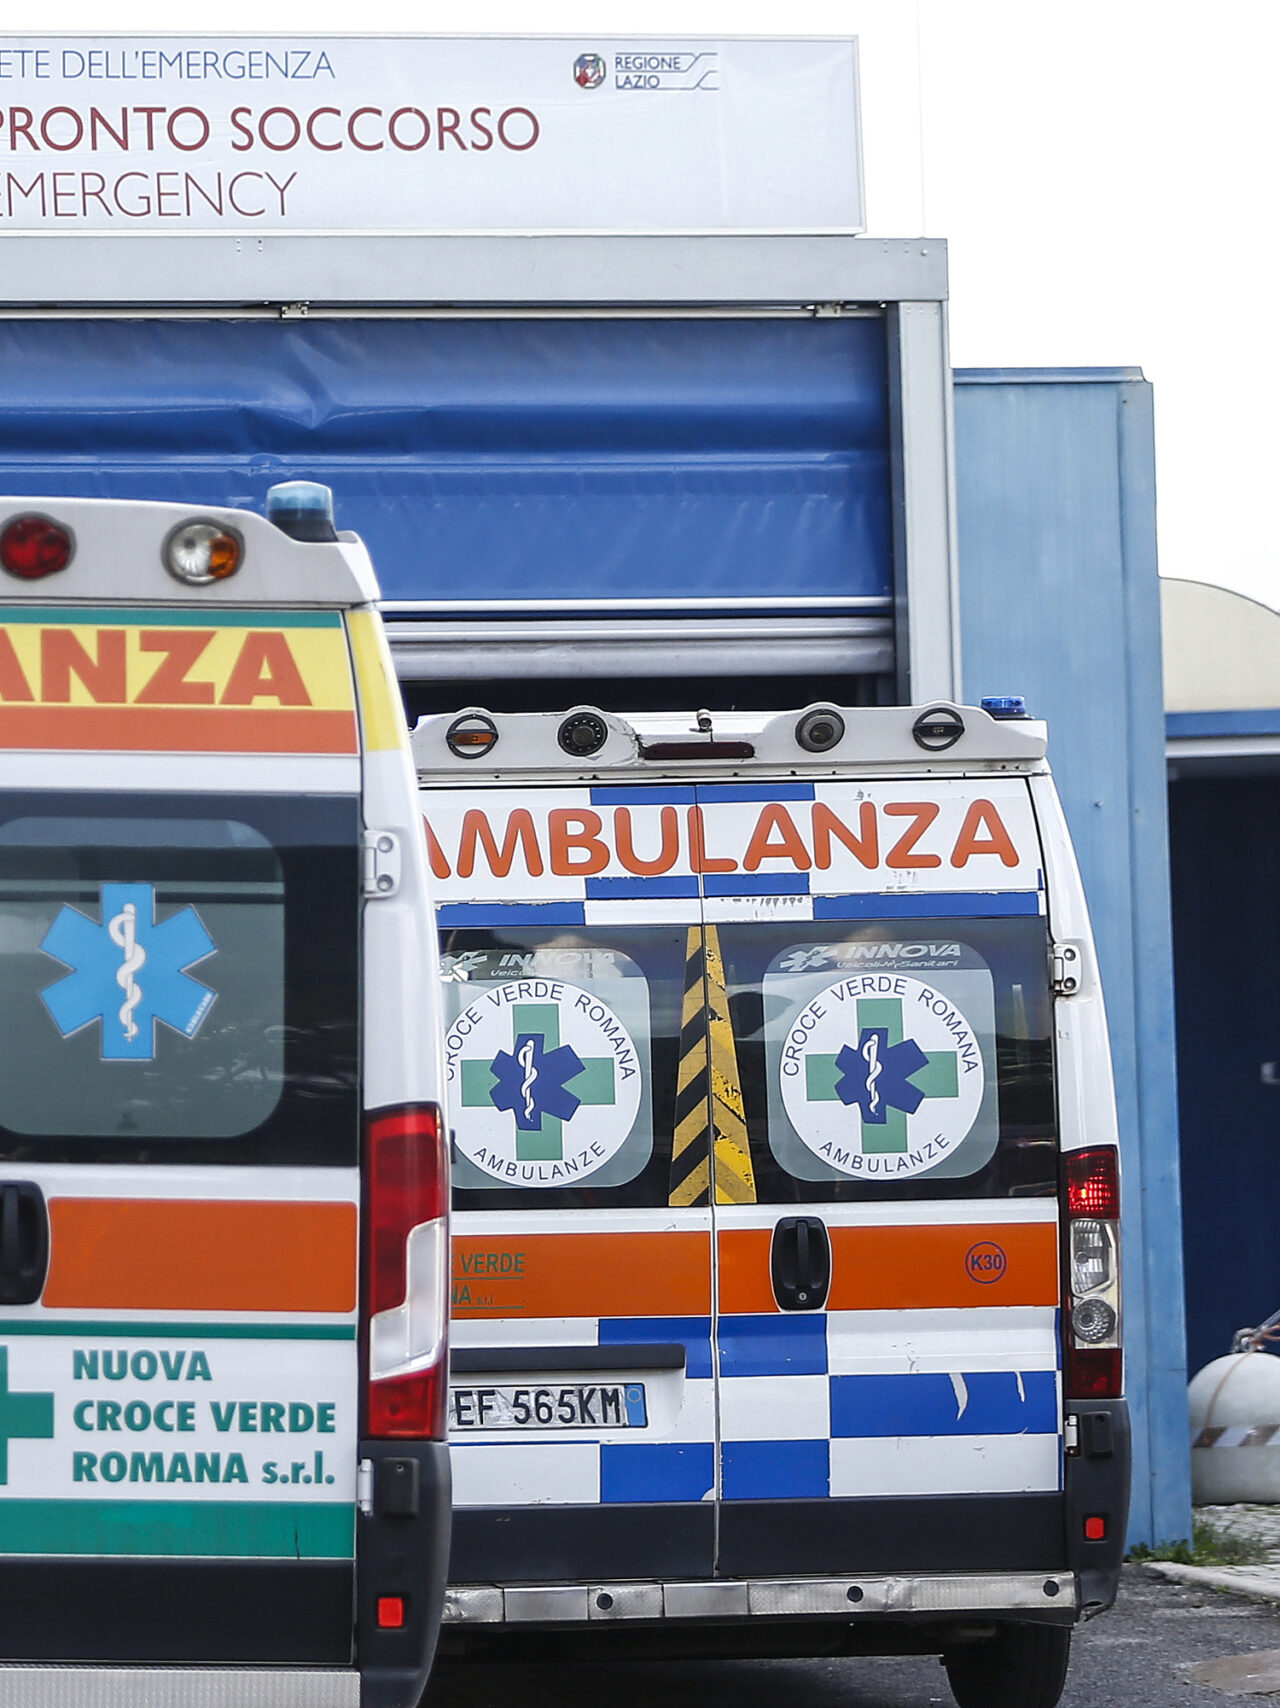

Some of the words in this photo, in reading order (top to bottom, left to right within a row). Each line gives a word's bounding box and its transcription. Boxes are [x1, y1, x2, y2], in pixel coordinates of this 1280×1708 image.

[62, 51, 336, 80] DELL'EMERGENZA
[615, 56, 681, 70] REGIONE
[615, 75, 660, 89] LAZIO
[230, 106, 540, 152] SOCCORSO
[844, 943, 961, 959] INNOVA
[487, 981, 564, 1008] VERDE
[574, 993, 636, 1081] ROMANA
[783, 1000, 827, 1077] CROCE
[830, 976, 908, 1002] VERDE
[917, 988, 979, 1074] ROMANA
[473, 1140, 606, 1181] AMBULANZE
[818, 1132, 950, 1174] AMBULANZE
[460, 1252, 526, 1274] VERDE
[970, 1254, 1003, 1271] K30
[72, 1349, 212, 1381] NUOVA
[73, 1399, 196, 1432] CROCE
[210, 1401, 336, 1433] VERDE
[454, 1388, 496, 1425] EF
[512, 1387, 621, 1426] 565KM
[72, 1450, 249, 1483] ROMANA
[262, 1450, 336, 1484] s.r.l.
